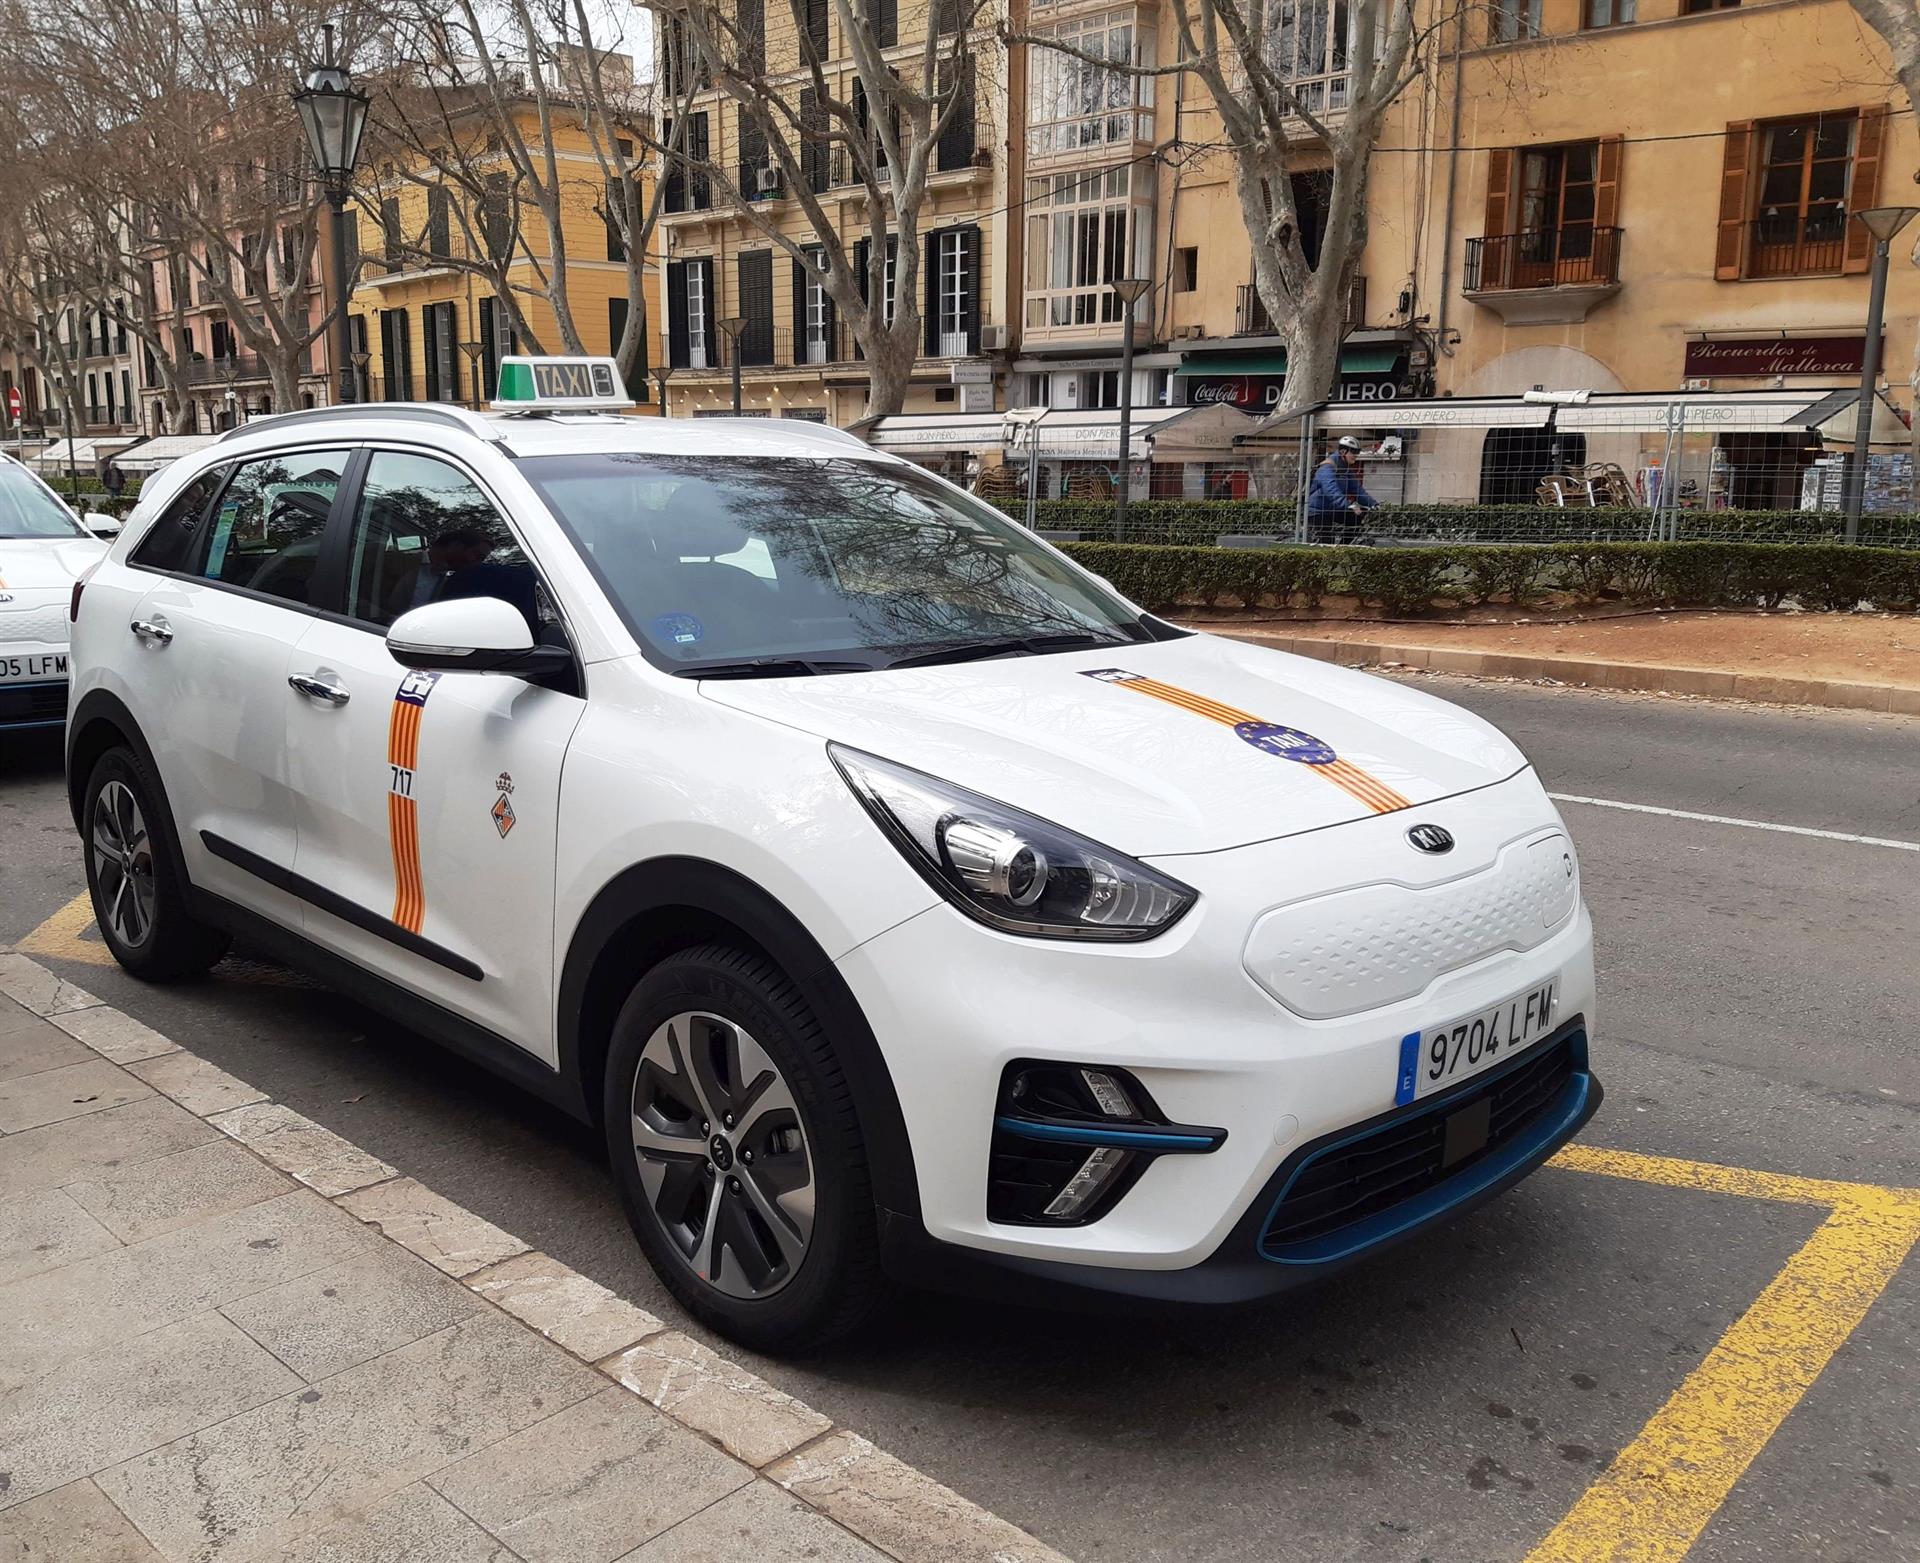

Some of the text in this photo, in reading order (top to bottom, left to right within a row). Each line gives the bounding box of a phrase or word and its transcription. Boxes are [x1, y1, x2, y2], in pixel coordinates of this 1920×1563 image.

[1691, 341, 1818, 359] Recuerdos de
[1759, 357, 1854, 373] Mallorca
[536, 365, 594, 397] TAXI
[1328, 382, 1396, 401] IERO
[1393, 410, 1457, 422] DON PIERO
[1694, 408, 1734, 420] PIERO
[1075, 429, 1098, 440] DON
[28, 655, 67, 675] LFM
[1260, 733, 1310, 749] TAXI
[391, 765, 412, 796] 717
[1411, 828, 1452, 849] KIA
[1429, 984, 1553, 1081] 9704 LFM
